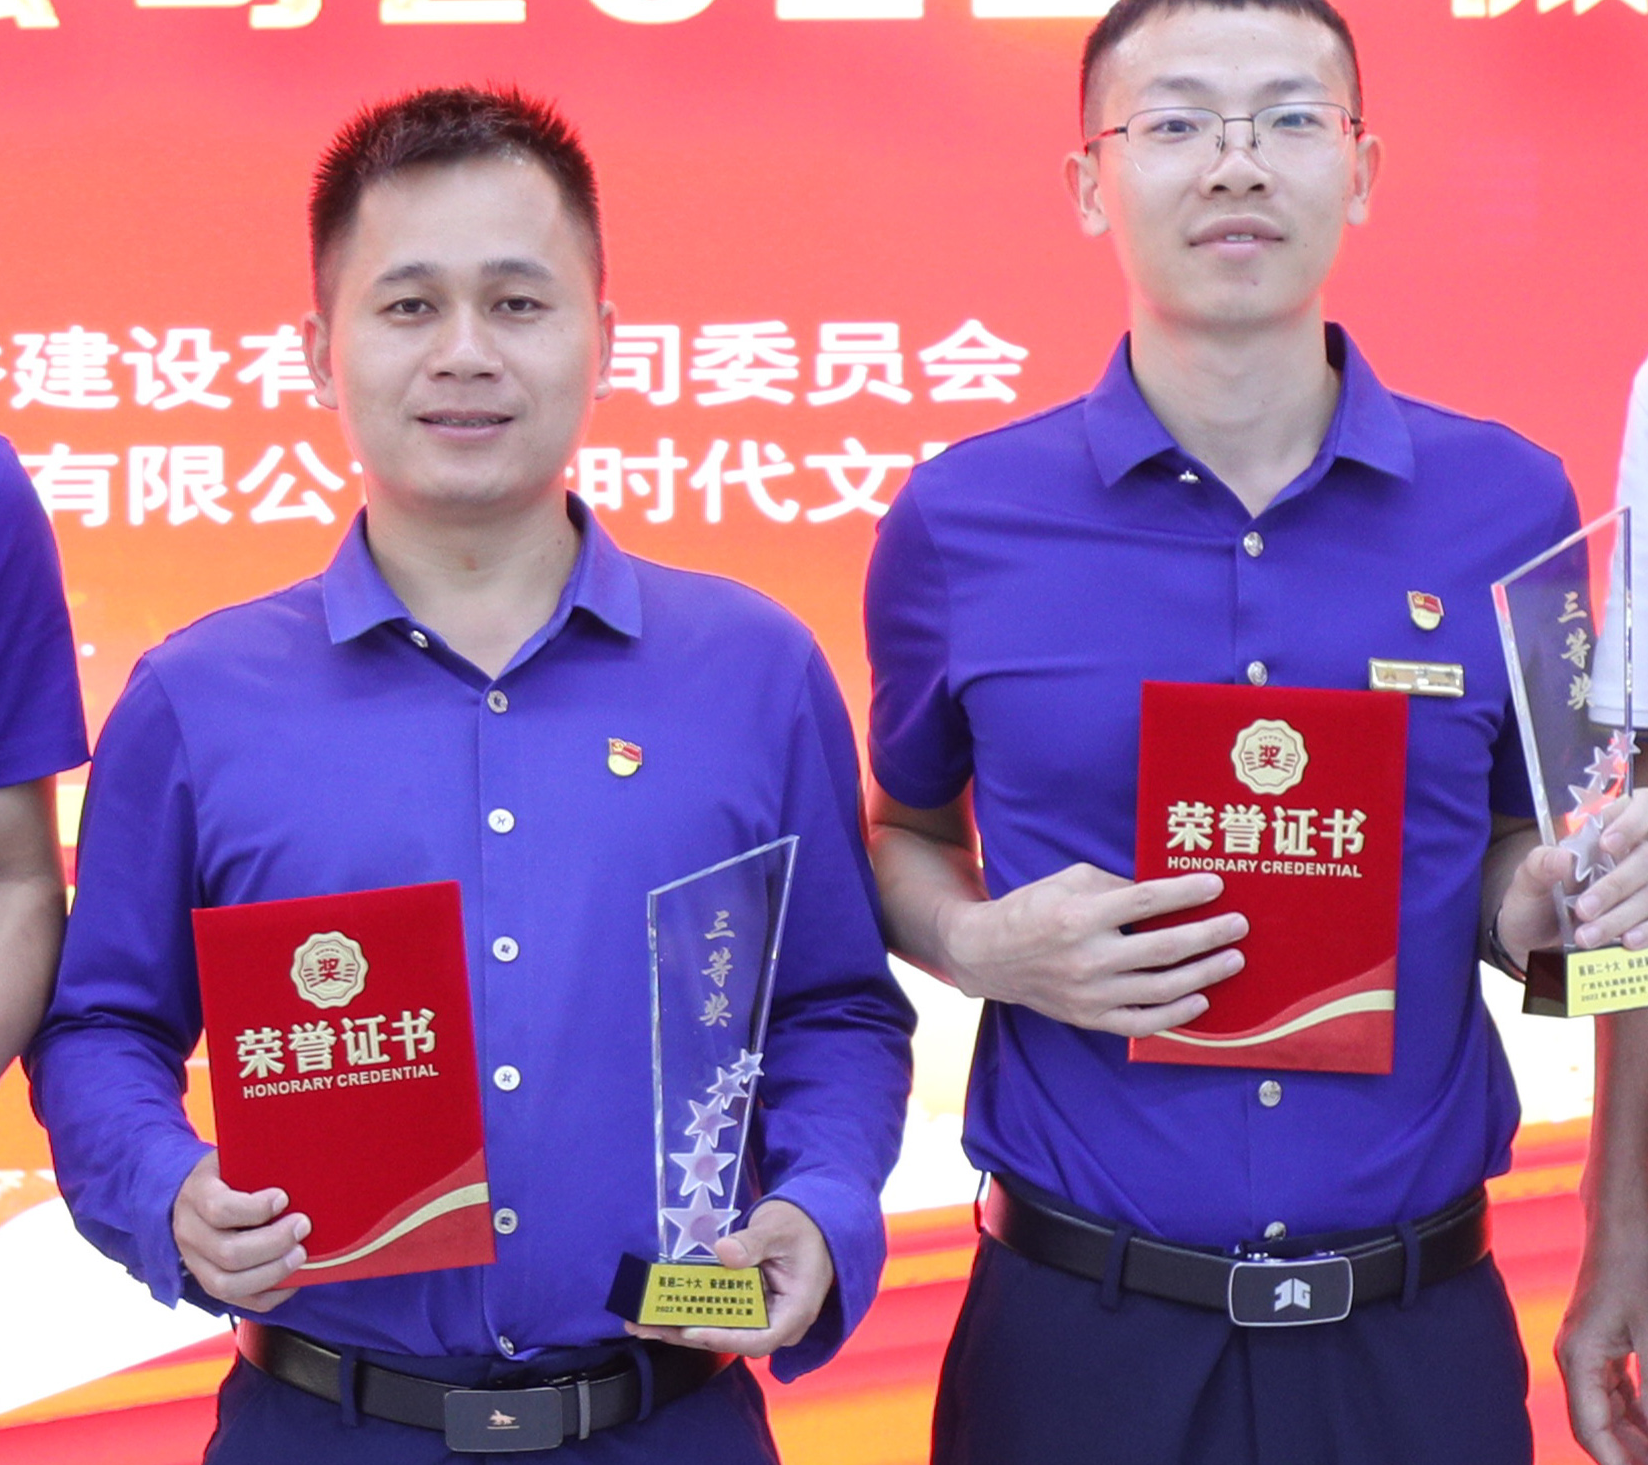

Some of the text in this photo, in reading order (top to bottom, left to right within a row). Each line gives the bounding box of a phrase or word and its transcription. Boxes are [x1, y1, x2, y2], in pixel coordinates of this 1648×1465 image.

[1556, 590, 1595, 711] 三等奖
[1259, 744, 1281, 769] 奖
[1166, 801, 1367, 859] 荣誉证书
[1167, 856, 1362, 878] HONORARY CREDENTIAL
[317, 958, 340, 982] 奖
[698, 909, 735, 1029] 三等奖
[235, 1008, 436, 1079] 荣誉证书
[243, 1064, 439, 1099] HONORARY CREDENTIAL
